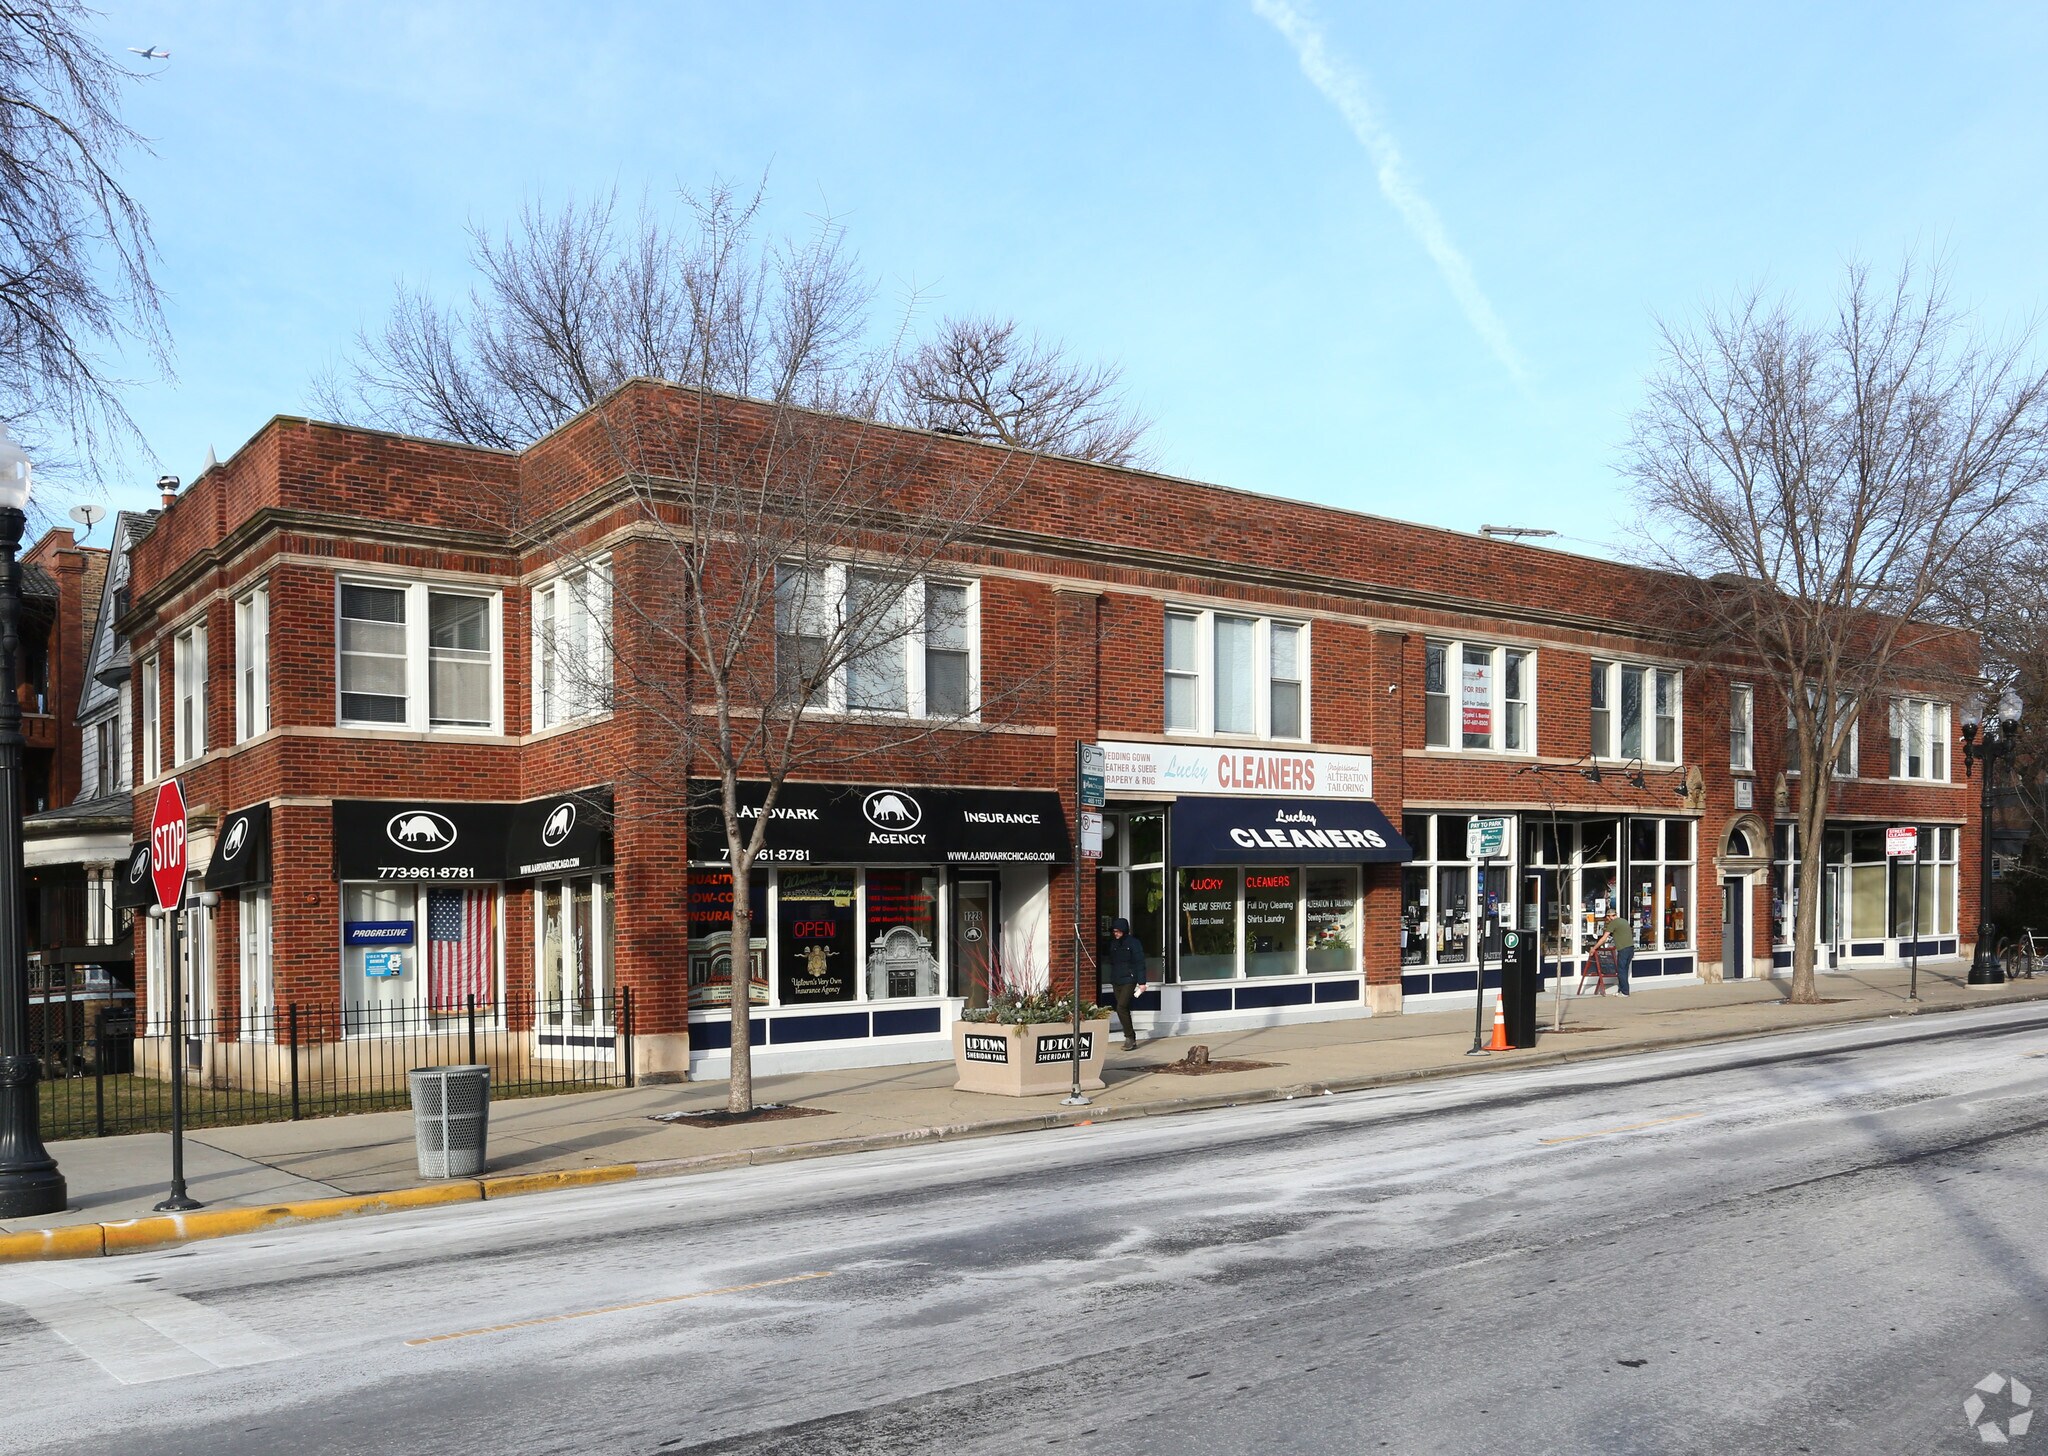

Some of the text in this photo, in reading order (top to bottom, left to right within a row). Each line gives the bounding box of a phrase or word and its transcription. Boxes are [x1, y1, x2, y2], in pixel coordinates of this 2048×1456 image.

[1132, 753, 1151, 762] GOWN
[1105, 763, 1130, 772] EATHER
[1132, 764, 1136, 773] &
[1138, 764, 1157, 773] SUEDE
[1164, 754, 1315, 792] Lucky CLEANERS
[1135, 776, 1140, 785] &
[1142, 776, 1156, 785] RUG
[1327, 773, 1369, 783] ALTERATION
[1328, 783, 1365, 793] TAILORING
[737, 805, 819, 820] ARVARK
[963, 811, 1041, 825] INSURANCE
[1489, 820, 1502, 828] PARK
[868, 832, 927, 845] AGENCY
[1229, 828, 1387, 849] CLEANERS
[154, 819, 185, 872] STOP
[720, 848, 810, 861] 761-8781
[947, 851, 1055, 861] WWW.AARDVARKCHICAGO.COM
[519, 857, 580, 875] WWW.AARDVARKCHICAGO.COM
[377, 867, 475, 879] 773-961-8781
[1191, 876, 1290, 890] LUCKY CLEANERS
[688, 892, 734, 903] OW-CO
[1182, 901, 1232, 912] SAME DAY SERVICE
[1247, 901, 1294, 911] Full Dry Cleaning
[688, 911, 753, 921] NSURAE
[1247, 914, 1285, 924] Shirts Laundry
[354, 928, 408, 938] PROGRESSIVE
[794, 922, 834, 937] OPEN
[817, 978, 829, 987] Very
[795, 986, 841, 996] Insurance Agency
[966, 1037, 1005, 1052] UPTOWN
[967, 1051, 1006, 1062] SHERIDAN PARK
[1038, 1052, 1071, 1062] SHERIDAN
